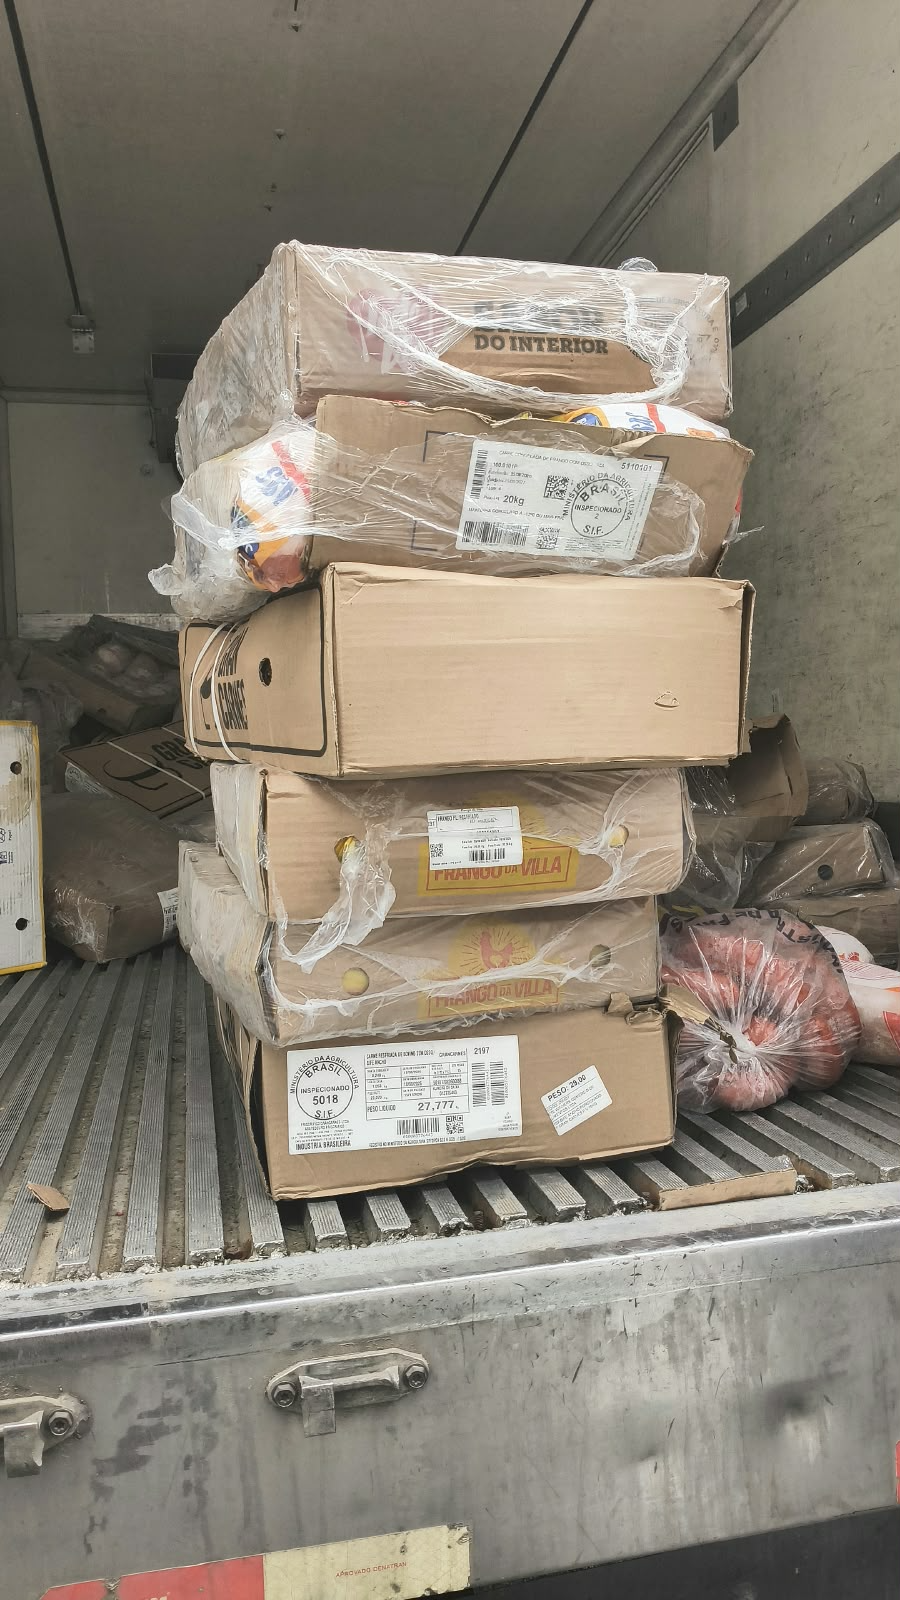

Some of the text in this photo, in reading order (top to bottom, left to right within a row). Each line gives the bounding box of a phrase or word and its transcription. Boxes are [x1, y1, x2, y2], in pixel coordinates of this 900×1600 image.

[473, 334, 609, 355] DO INTERIOR
[621, 462, 653, 472] 5110101
[597, 472, 609, 480] DA
[579, 482, 626, 506] BRASIL
[502, 494, 525, 507] 20kg
[574, 503, 622, 514] INSPECIONADO
[521, 855, 562, 877] VILLA
[500, 985, 511, 996] DA
[514, 978, 553, 998] VILLA
[473, 1046, 490, 1055] 2197
[304, 1062, 343, 1079] BRASIL
[325, 1055, 360, 1089] AGRICULTURA
[300, 1084, 350, 1095] INSPECIONADO
[547, 1086, 569, 1102] PESO:
[312, 1094, 339, 1106] 5018
[417, 1100, 455, 1111] 27,777
[323, 1139, 352, 1149] BRASILEIRA
[335, 1567, 371, 1578] APROVADO
